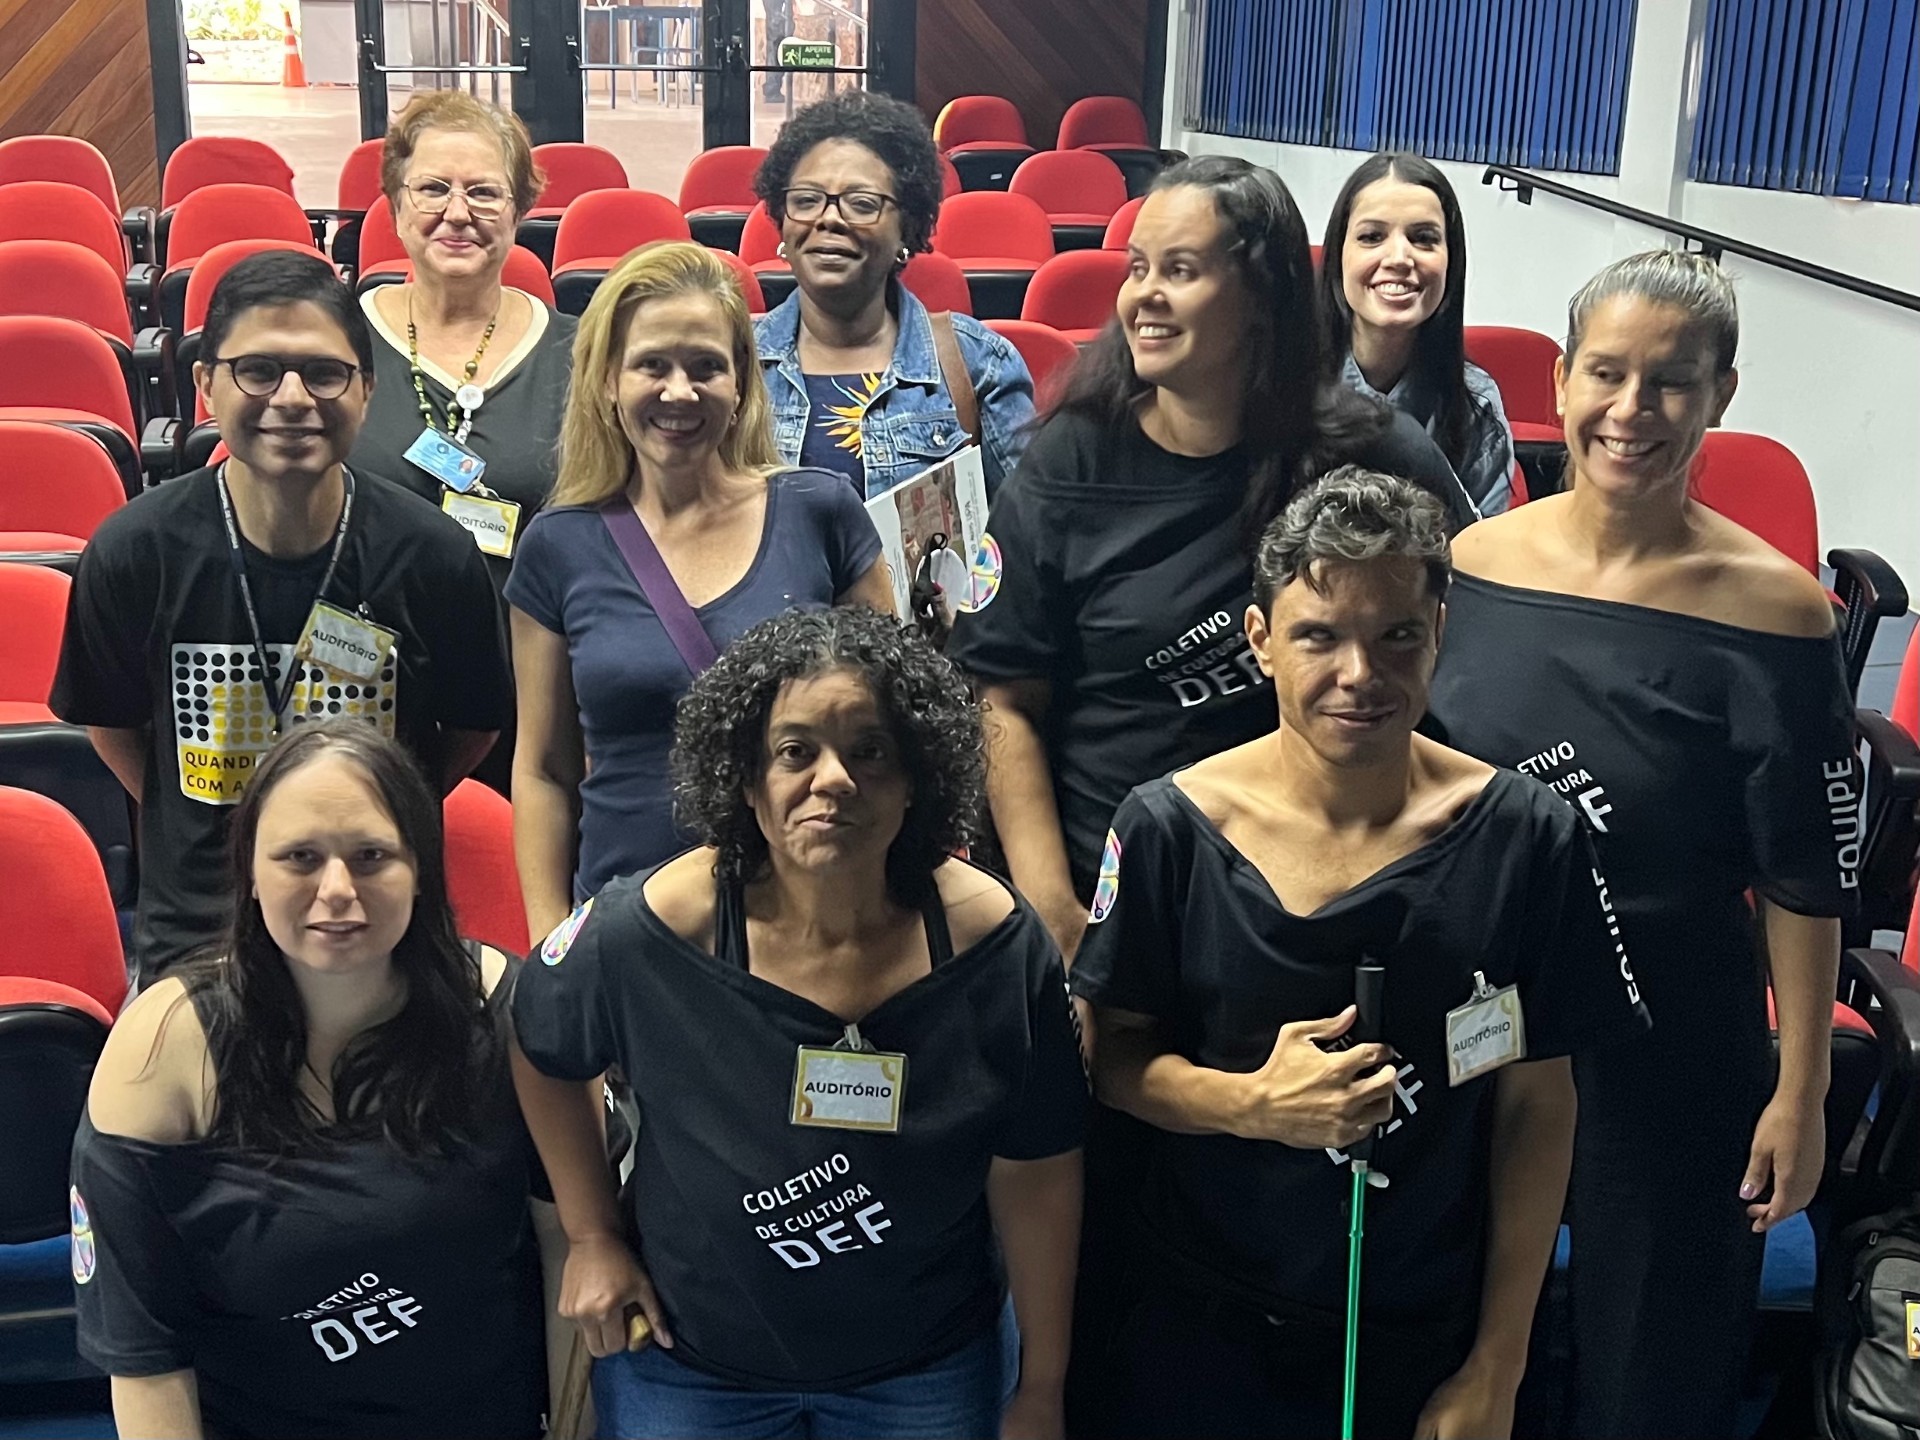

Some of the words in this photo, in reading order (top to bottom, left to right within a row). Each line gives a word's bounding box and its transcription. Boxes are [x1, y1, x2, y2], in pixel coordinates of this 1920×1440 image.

[311, 629, 378, 662] AUDITÓRIO
[1145, 610, 1231, 669] COLETIVO
[1170, 649, 1263, 707] DEF
[186, 774, 223, 793] COM
[1453, 1021, 1511, 1053] AUDITÓRIO
[804, 1081, 892, 1098] AUDITÓRIO
[742, 1153, 850, 1214] COLETIVO
[755, 1222, 782, 1240] DE
[784, 1183, 872, 1233] CULTURA
[768, 1201, 892, 1269] DEF
[311, 1296, 423, 1363] DEF
